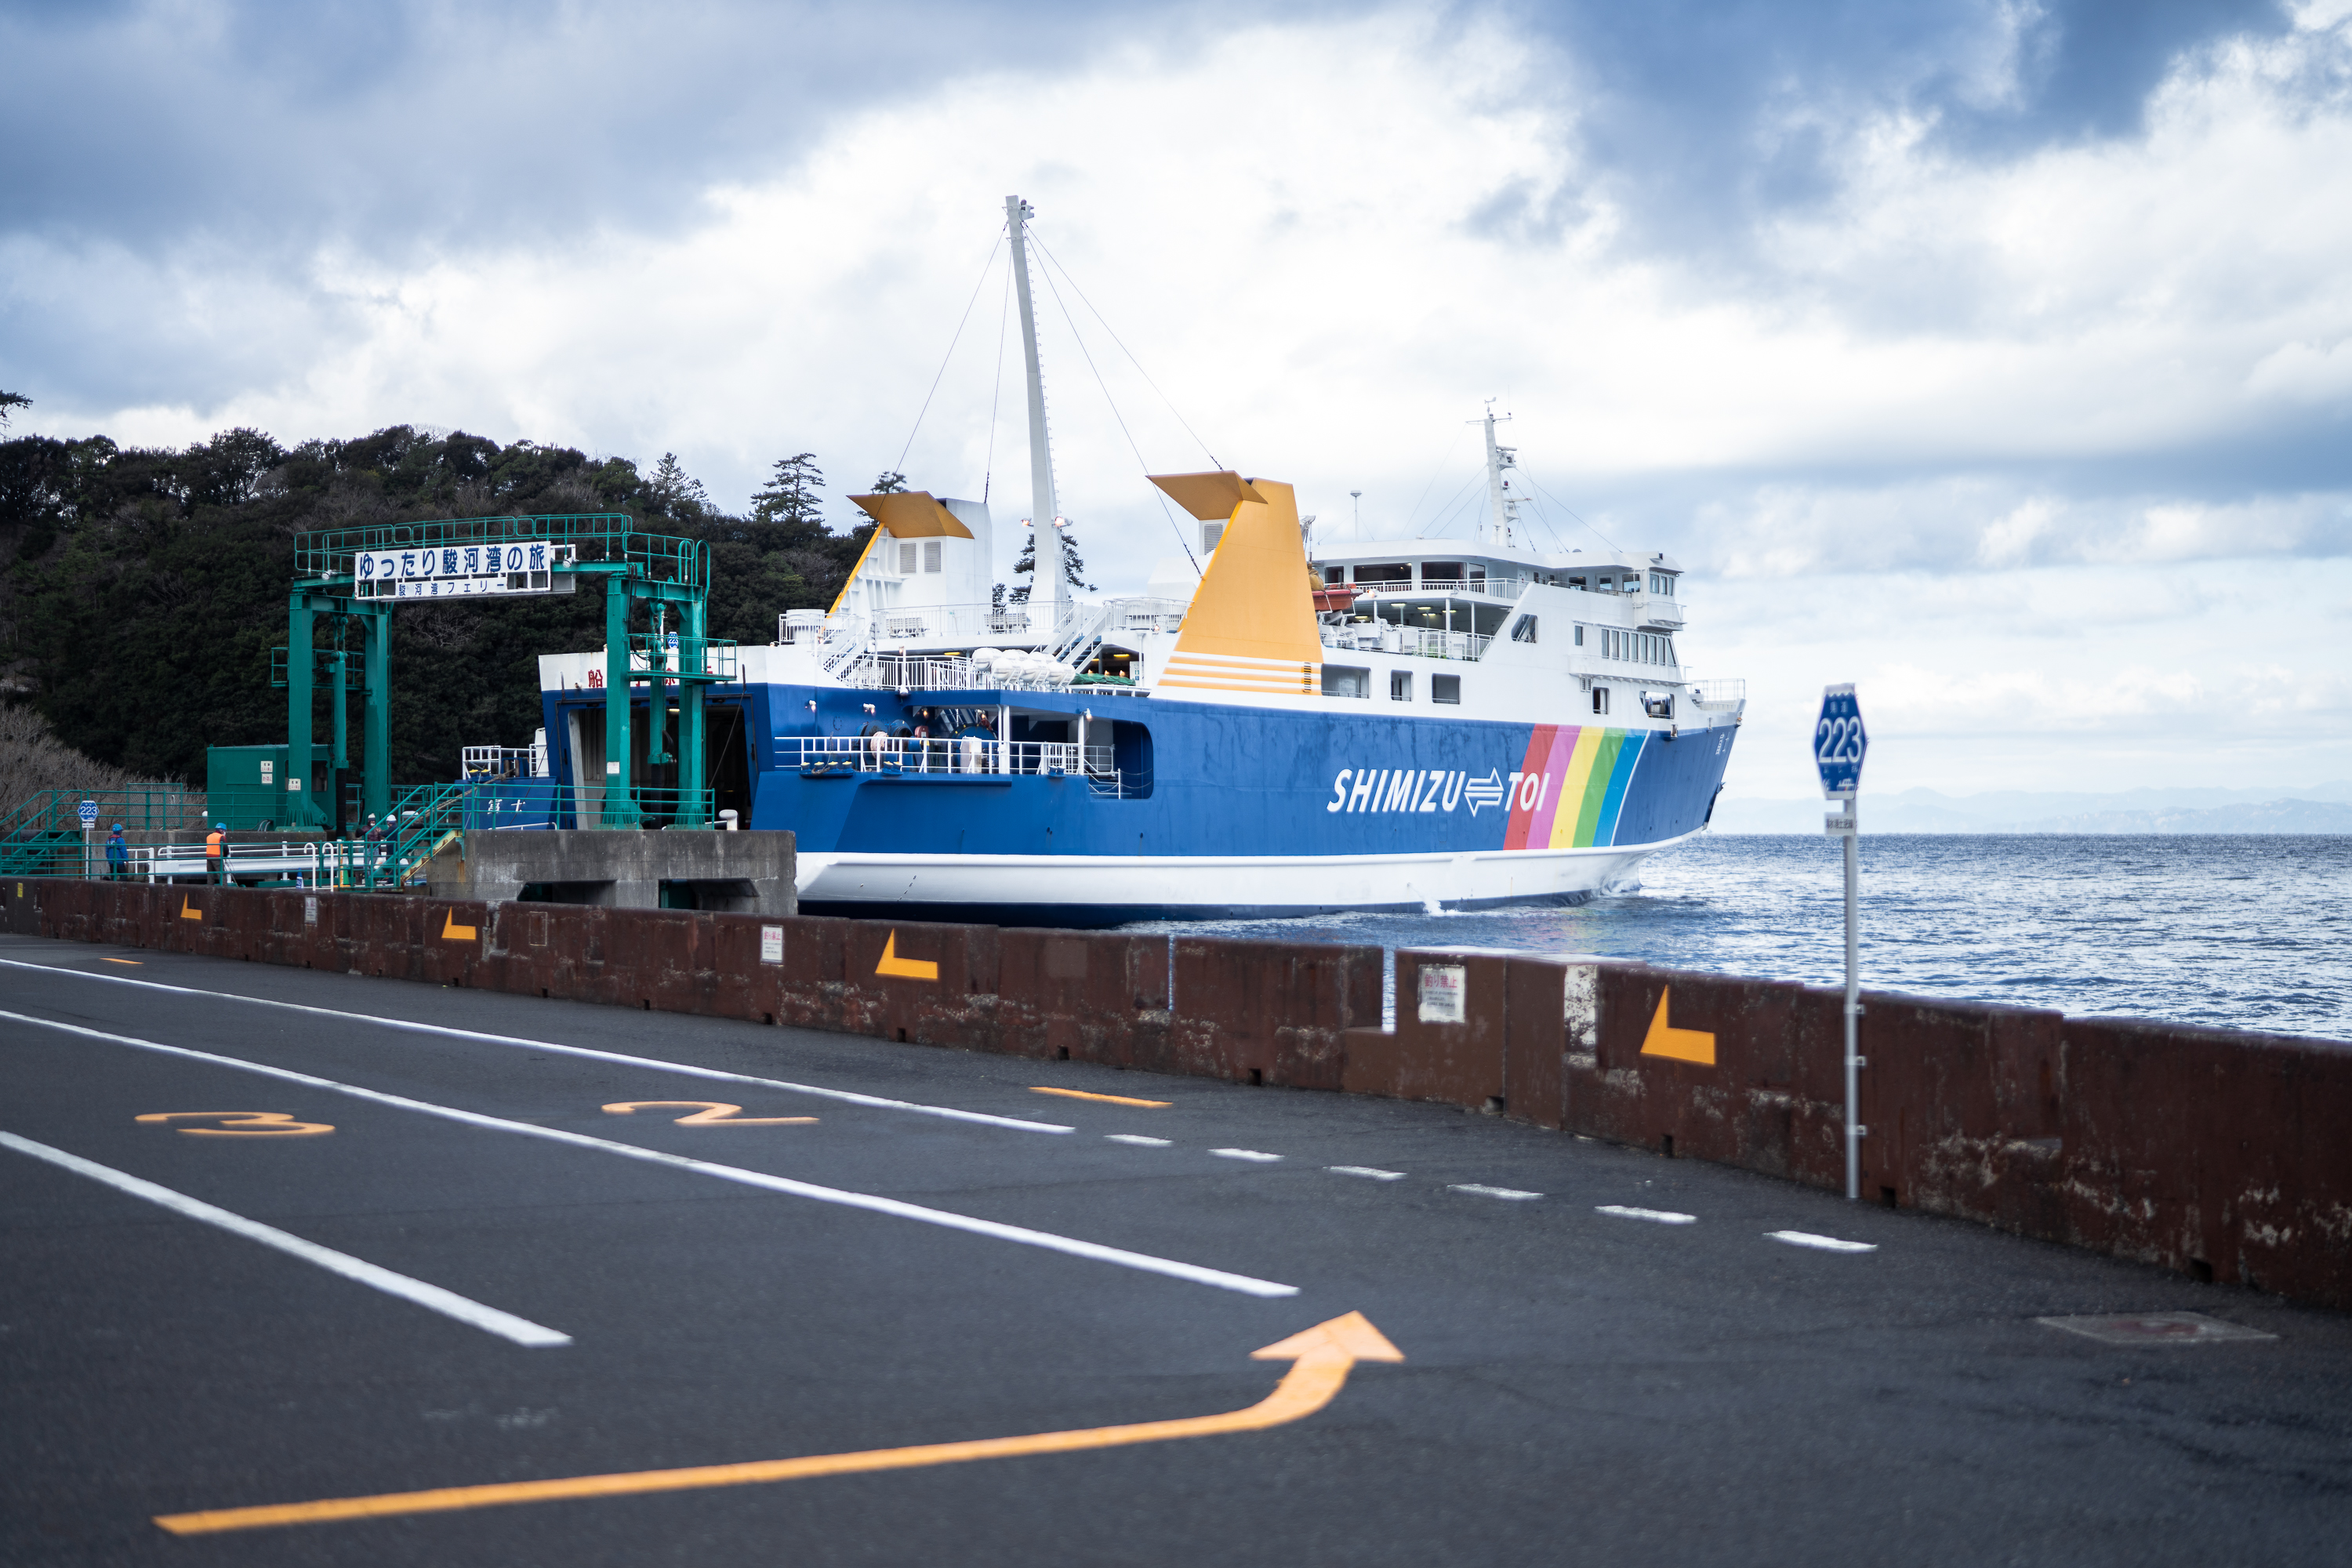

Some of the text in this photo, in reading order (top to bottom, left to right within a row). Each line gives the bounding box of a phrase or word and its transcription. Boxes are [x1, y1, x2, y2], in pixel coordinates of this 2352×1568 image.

[359, 543, 545, 579] ゆったり駿河湾の旅
[398, 580, 505, 597] 駿河湾フェリー
[1818, 716, 1862, 763] 223
[1327, 768, 1551, 812] SHIMIZU TOI
[80, 806, 97, 815] 223
[1425, 974, 1457, 988] 釣り禁止
[134, 1112, 336, 1135] 3
[601, 1101, 820, 1126] 2
